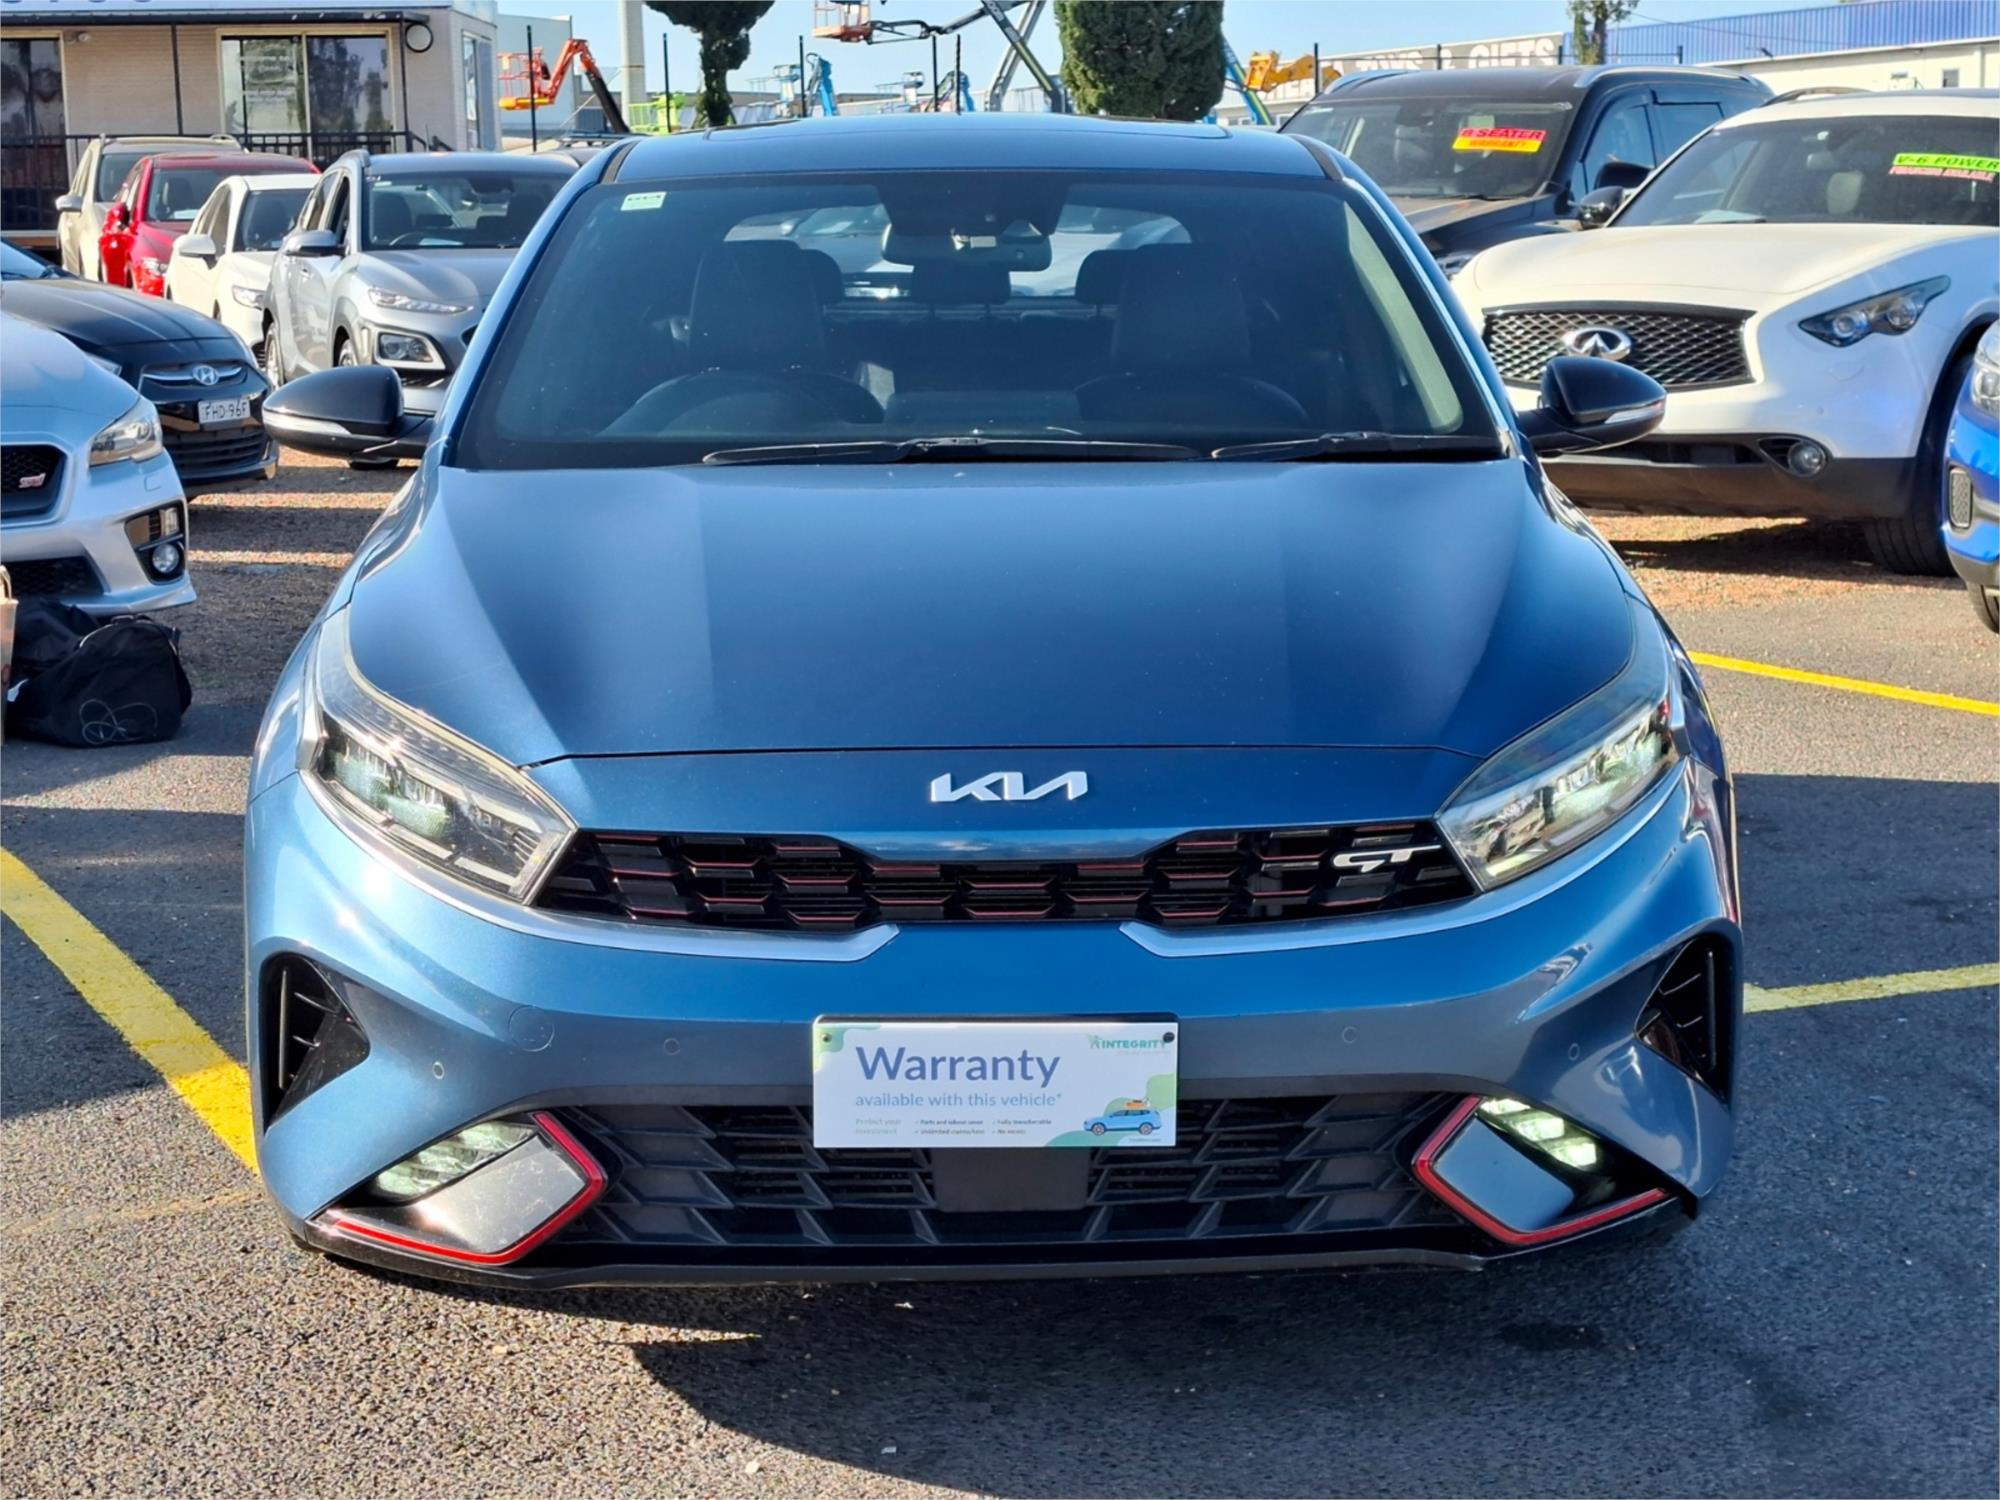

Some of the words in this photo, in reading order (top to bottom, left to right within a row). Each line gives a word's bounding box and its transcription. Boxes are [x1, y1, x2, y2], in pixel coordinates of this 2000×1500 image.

[1476, 128, 1543, 140] SEATER
[1934, 157, 1999, 170] POWER
[1333, 845, 1441, 873] GT
[855, 1046, 1060, 1088] Warranty
[855, 1093, 924, 1107] available
[928, 1093, 963, 1107] with
[968, 1093, 996, 1107] this
